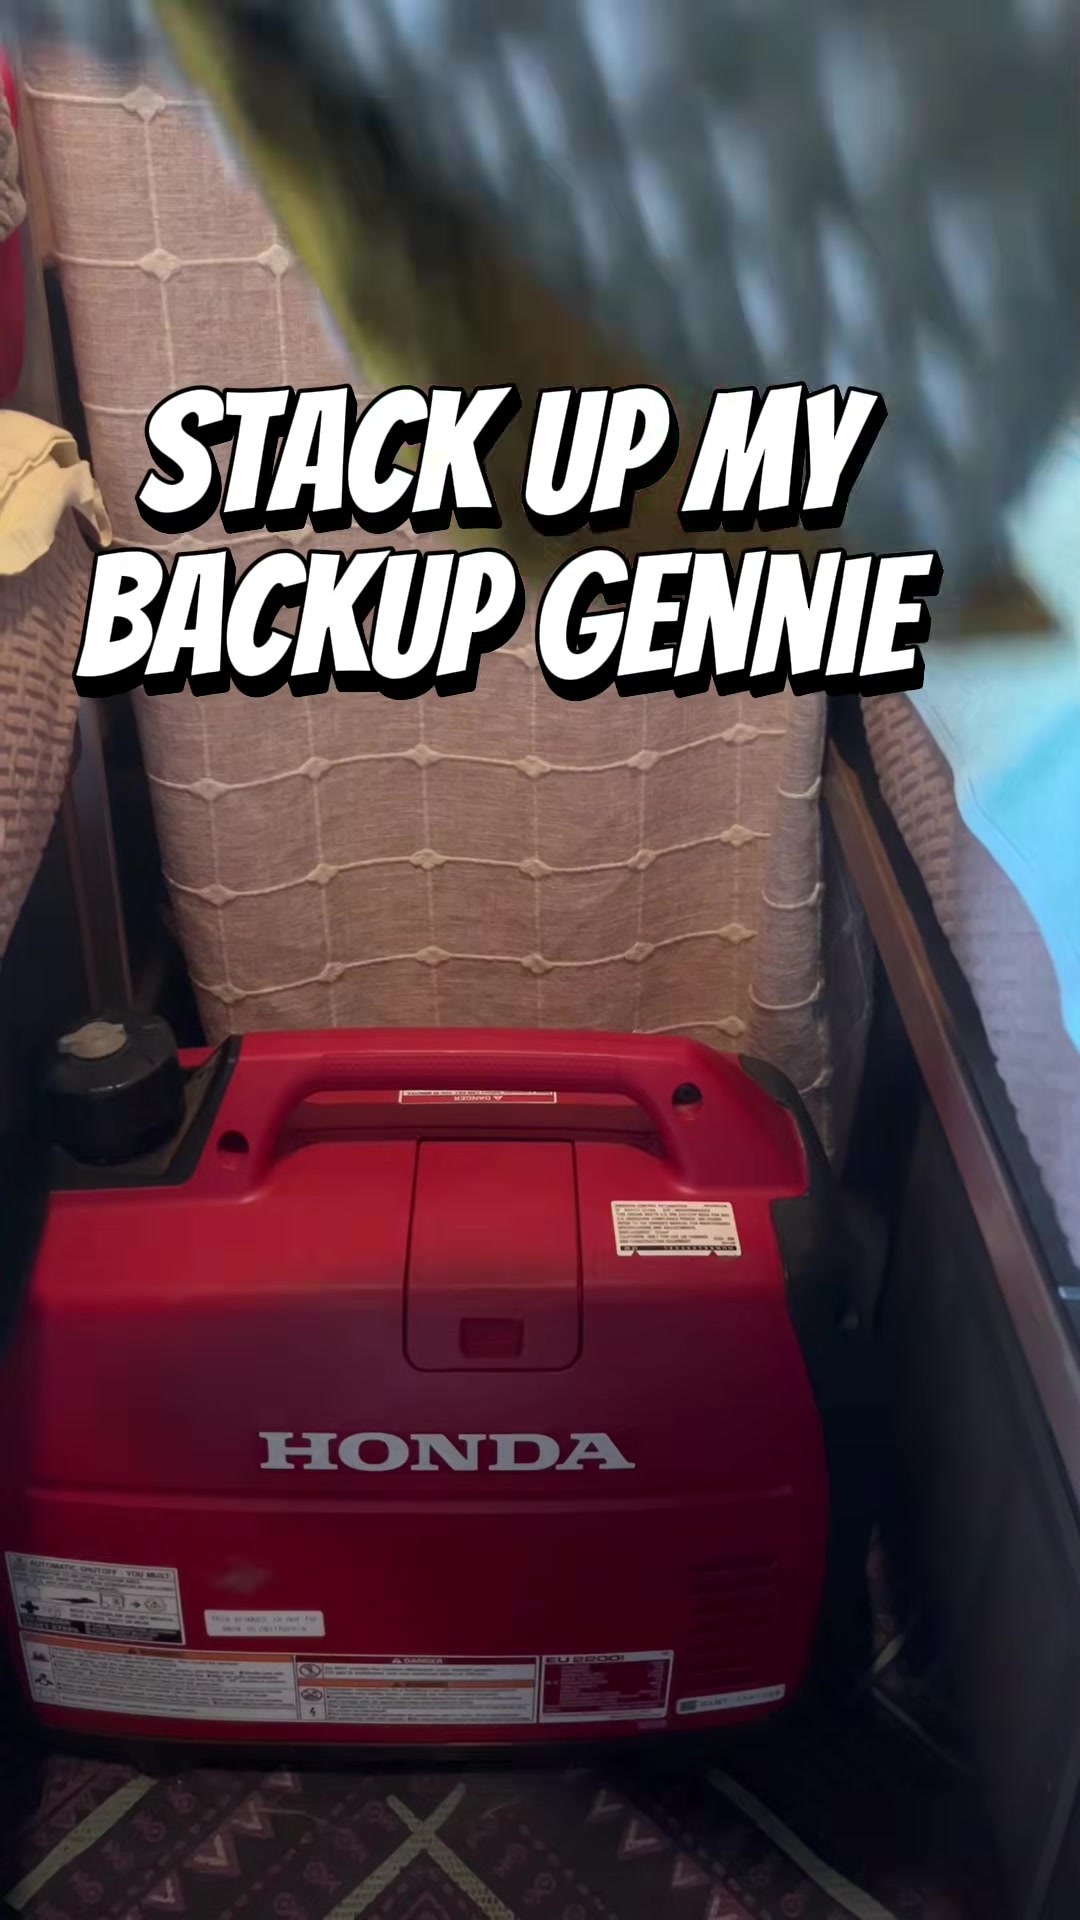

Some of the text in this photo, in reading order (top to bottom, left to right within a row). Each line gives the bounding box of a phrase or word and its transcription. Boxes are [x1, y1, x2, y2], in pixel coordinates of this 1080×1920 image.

[259, 1431, 636, 1472] HONDA
[30, 1560, 75, 1572] AUTOMATIC
[80, 1566, 117, 1575] SHUTOFF
[126, 1570, 144, 1578] YOU
